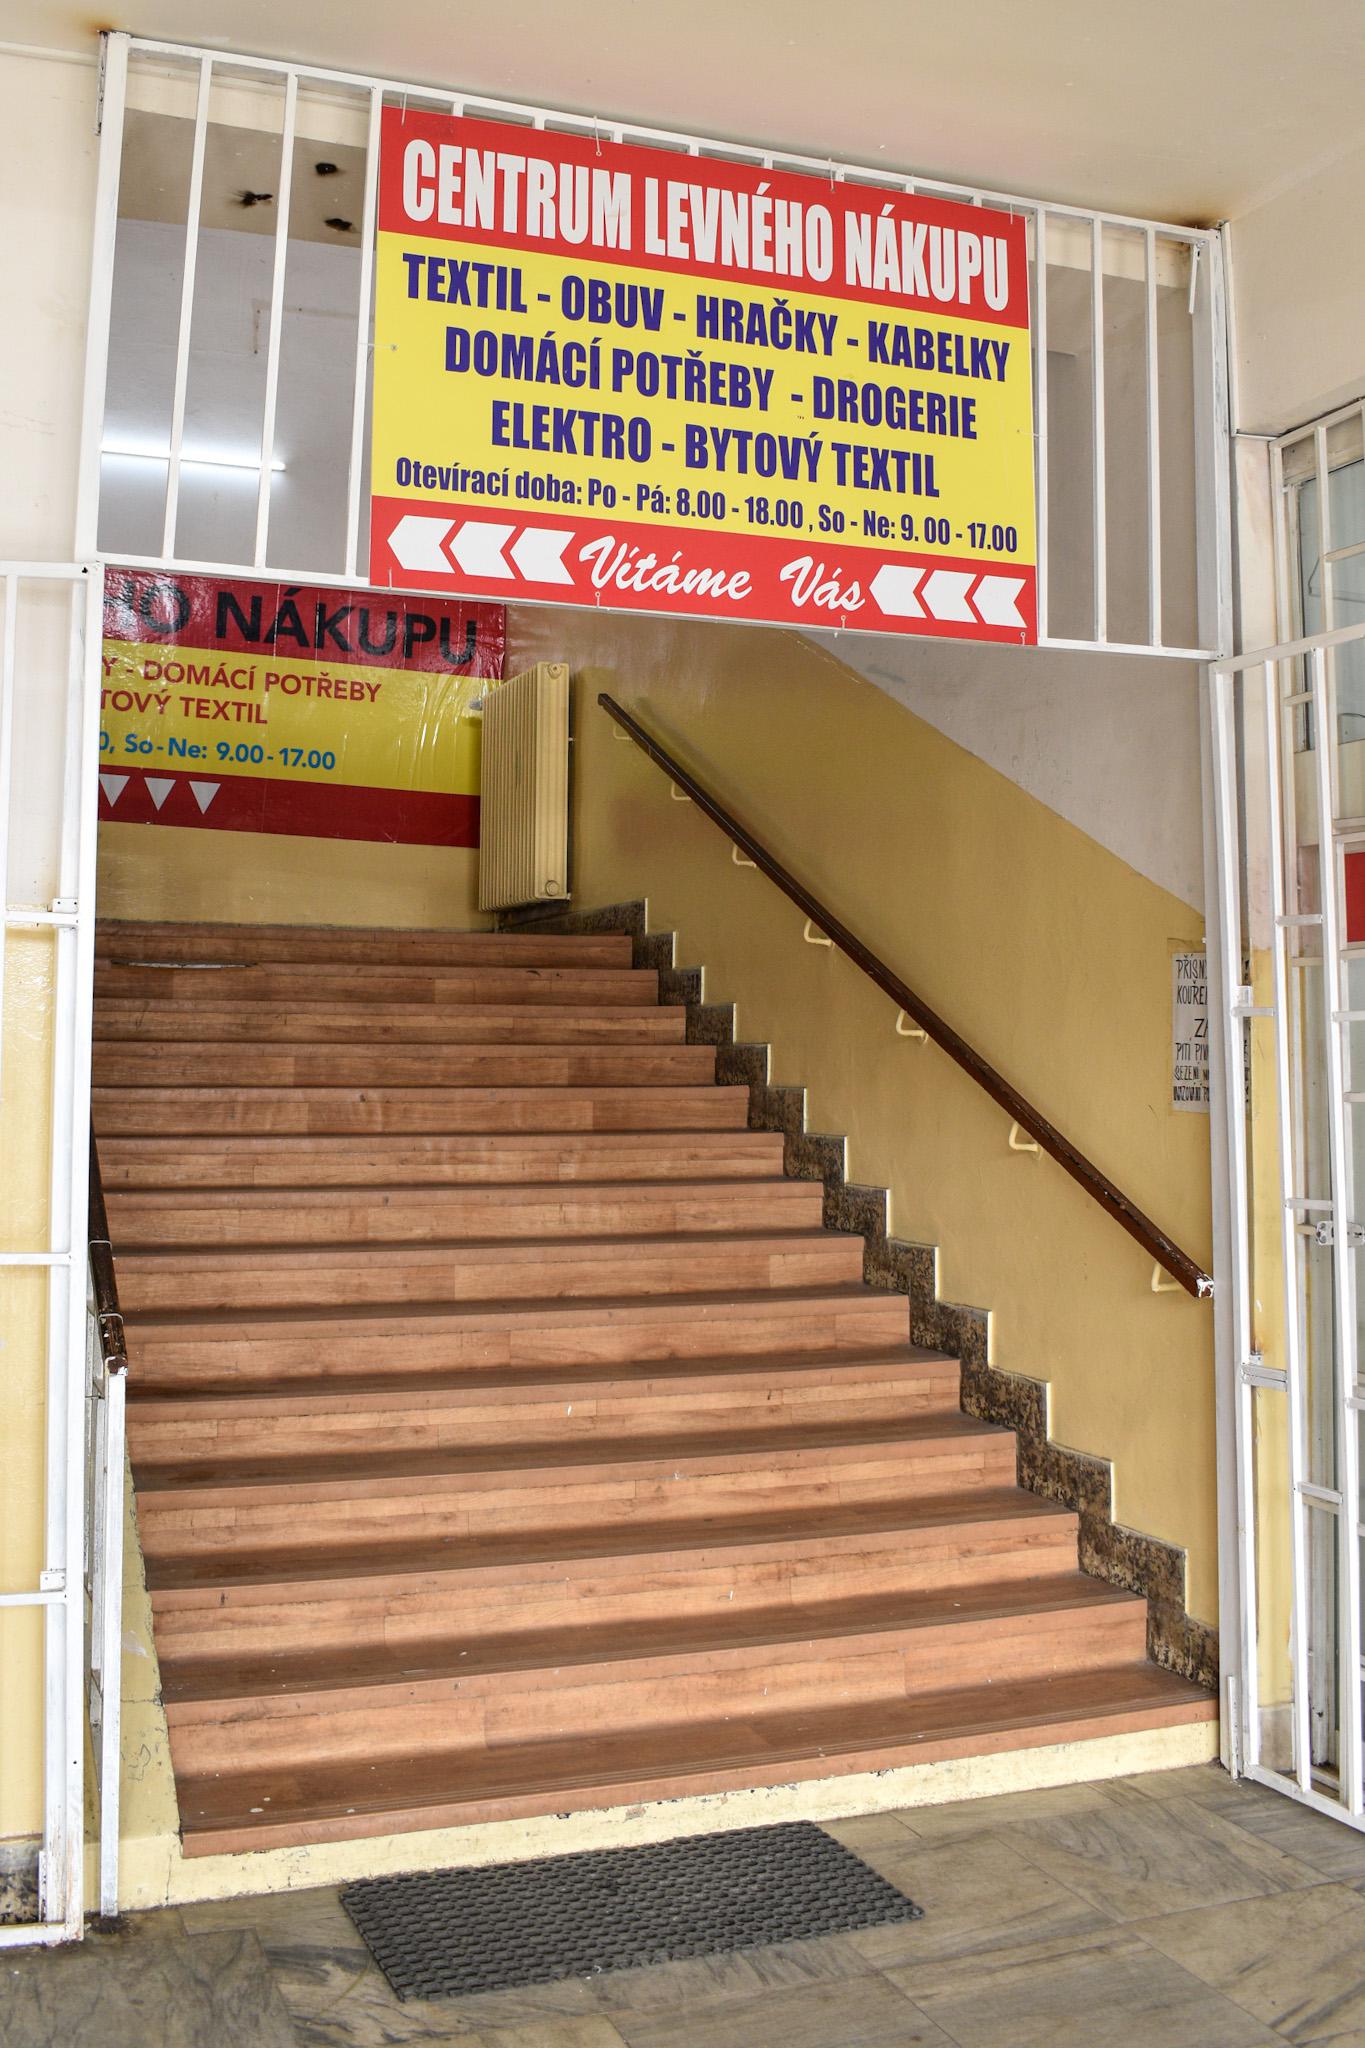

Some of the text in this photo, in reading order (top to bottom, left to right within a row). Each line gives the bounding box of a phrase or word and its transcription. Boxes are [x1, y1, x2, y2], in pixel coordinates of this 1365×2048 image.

[403, 139, 1009, 312] CENTRUM LEVNÉHO NÁKUPU
[402, 253, 527, 313] TEXTIL
[562, 276, 664, 331] OBUV
[697, 294, 838, 356] HRAČKY
[868, 321, 1010, 382] KABELKY
[445, 326, 601, 389] DOMÁCÍ
[612, 348, 774, 412] POTŘEBY
[813, 376, 977, 439] DROGERIE
[492, 400, 651, 463] ELEKTRO
[685, 424, 823, 483] BYTOVÝ
[831, 442, 940, 497] TEXTIL
[396, 457, 509, 497] Otevírací
[515, 471, 582, 505] doba:
[588, 478, 616, 509] Po
[636, 483, 671, 514] Pá:
[676, 488, 726, 520] 8.00
[818, 504, 845, 534] So
[863, 510, 895, 540] Ne:
[967, 523, 1018, 553] 17.00
[578, 535, 866, 612] Vítáme Vás
[216, 586, 478, 666] NÁKUPU
[143, 660, 256, 691] DOMÁCÍ
[264, 672, 382, 703] POTŘEBY
[179, 696, 268, 724] TEXTIL
[1176, 953, 1207, 979] PŘÍSN
